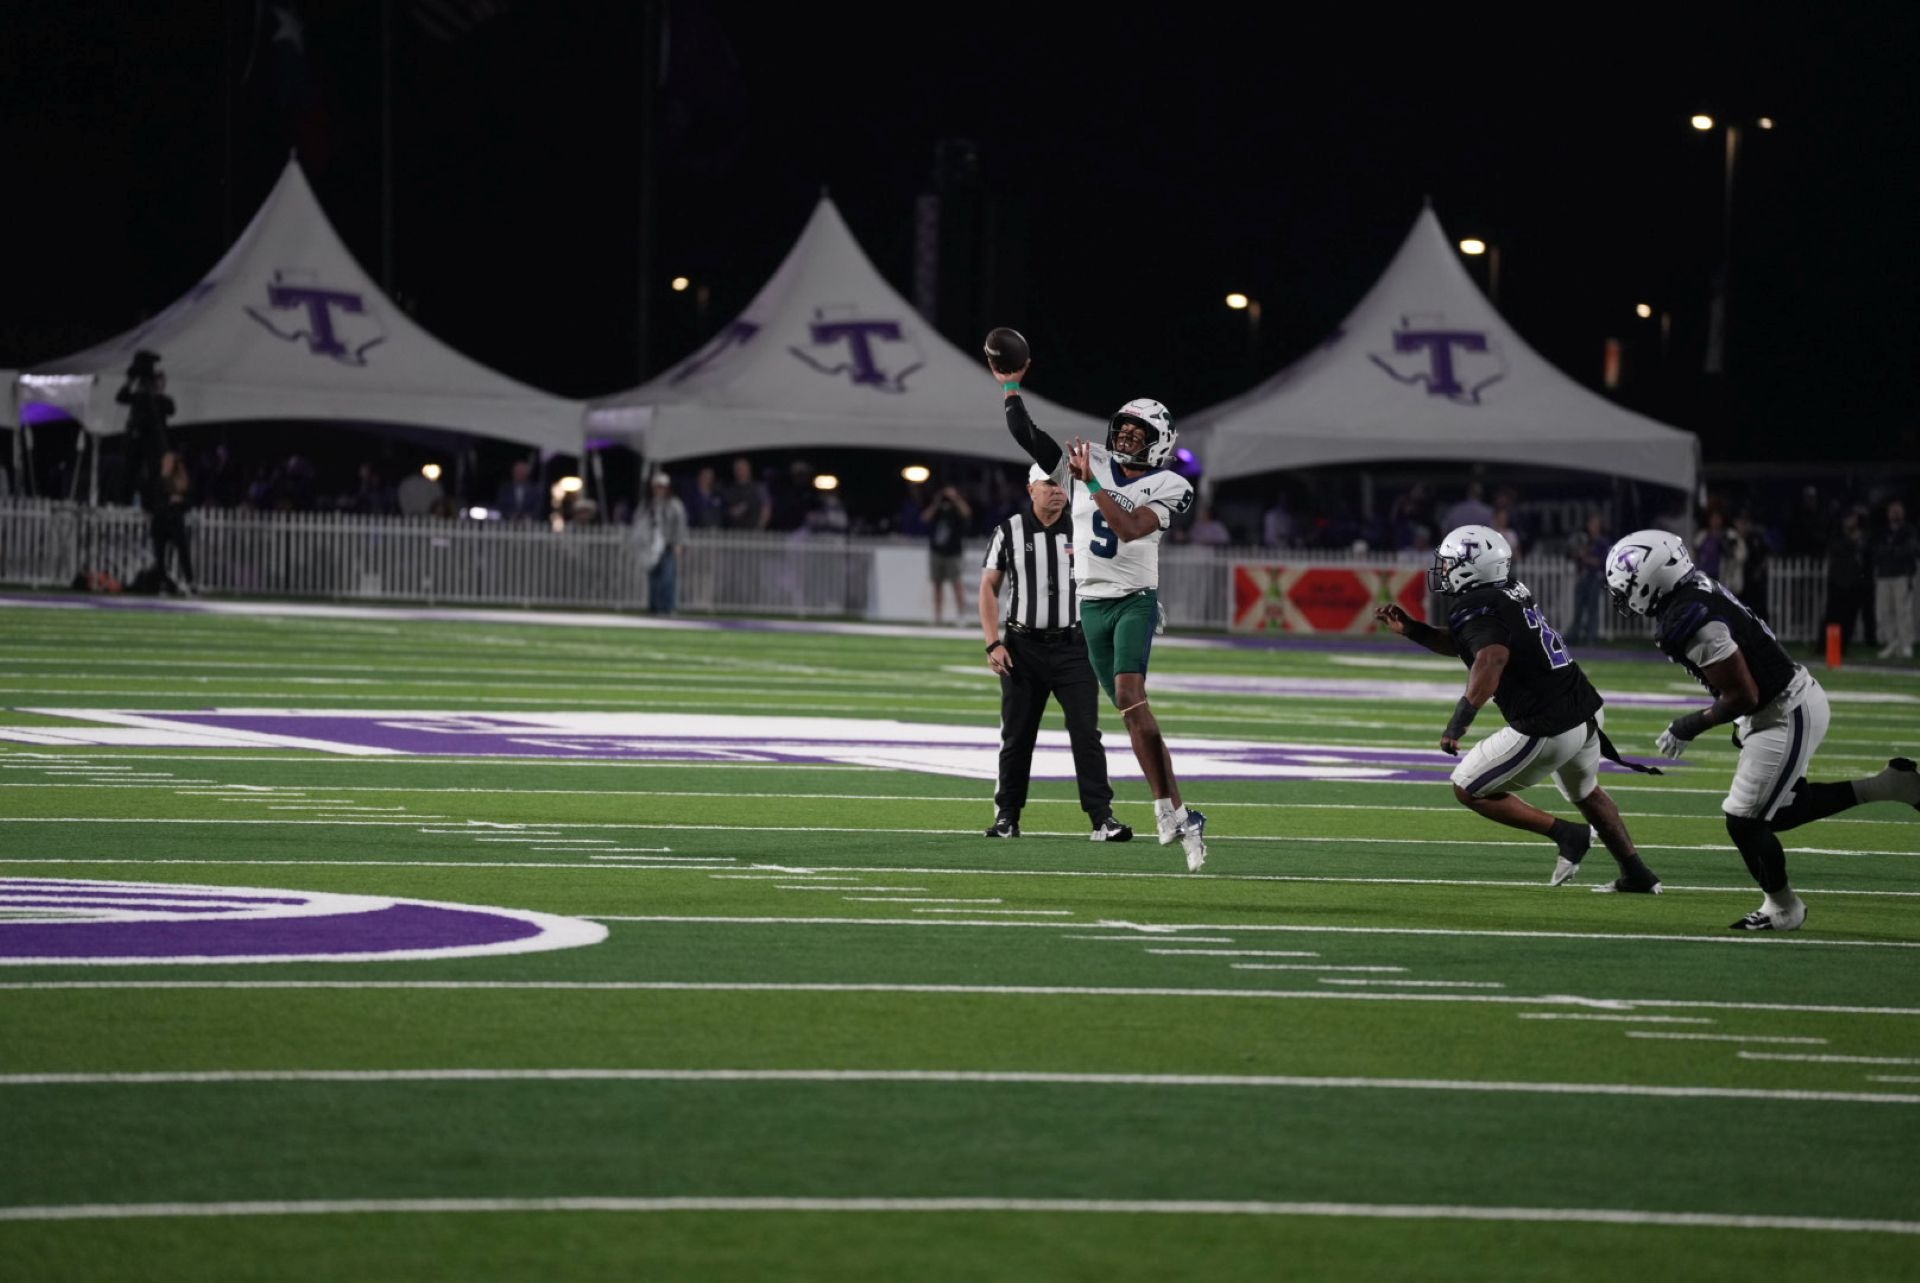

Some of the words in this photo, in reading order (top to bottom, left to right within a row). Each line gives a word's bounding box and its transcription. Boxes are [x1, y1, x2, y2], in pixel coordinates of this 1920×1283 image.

[268, 282, 363, 356] T
[811, 322, 901, 384] T
[1394, 331, 1487, 394] T
